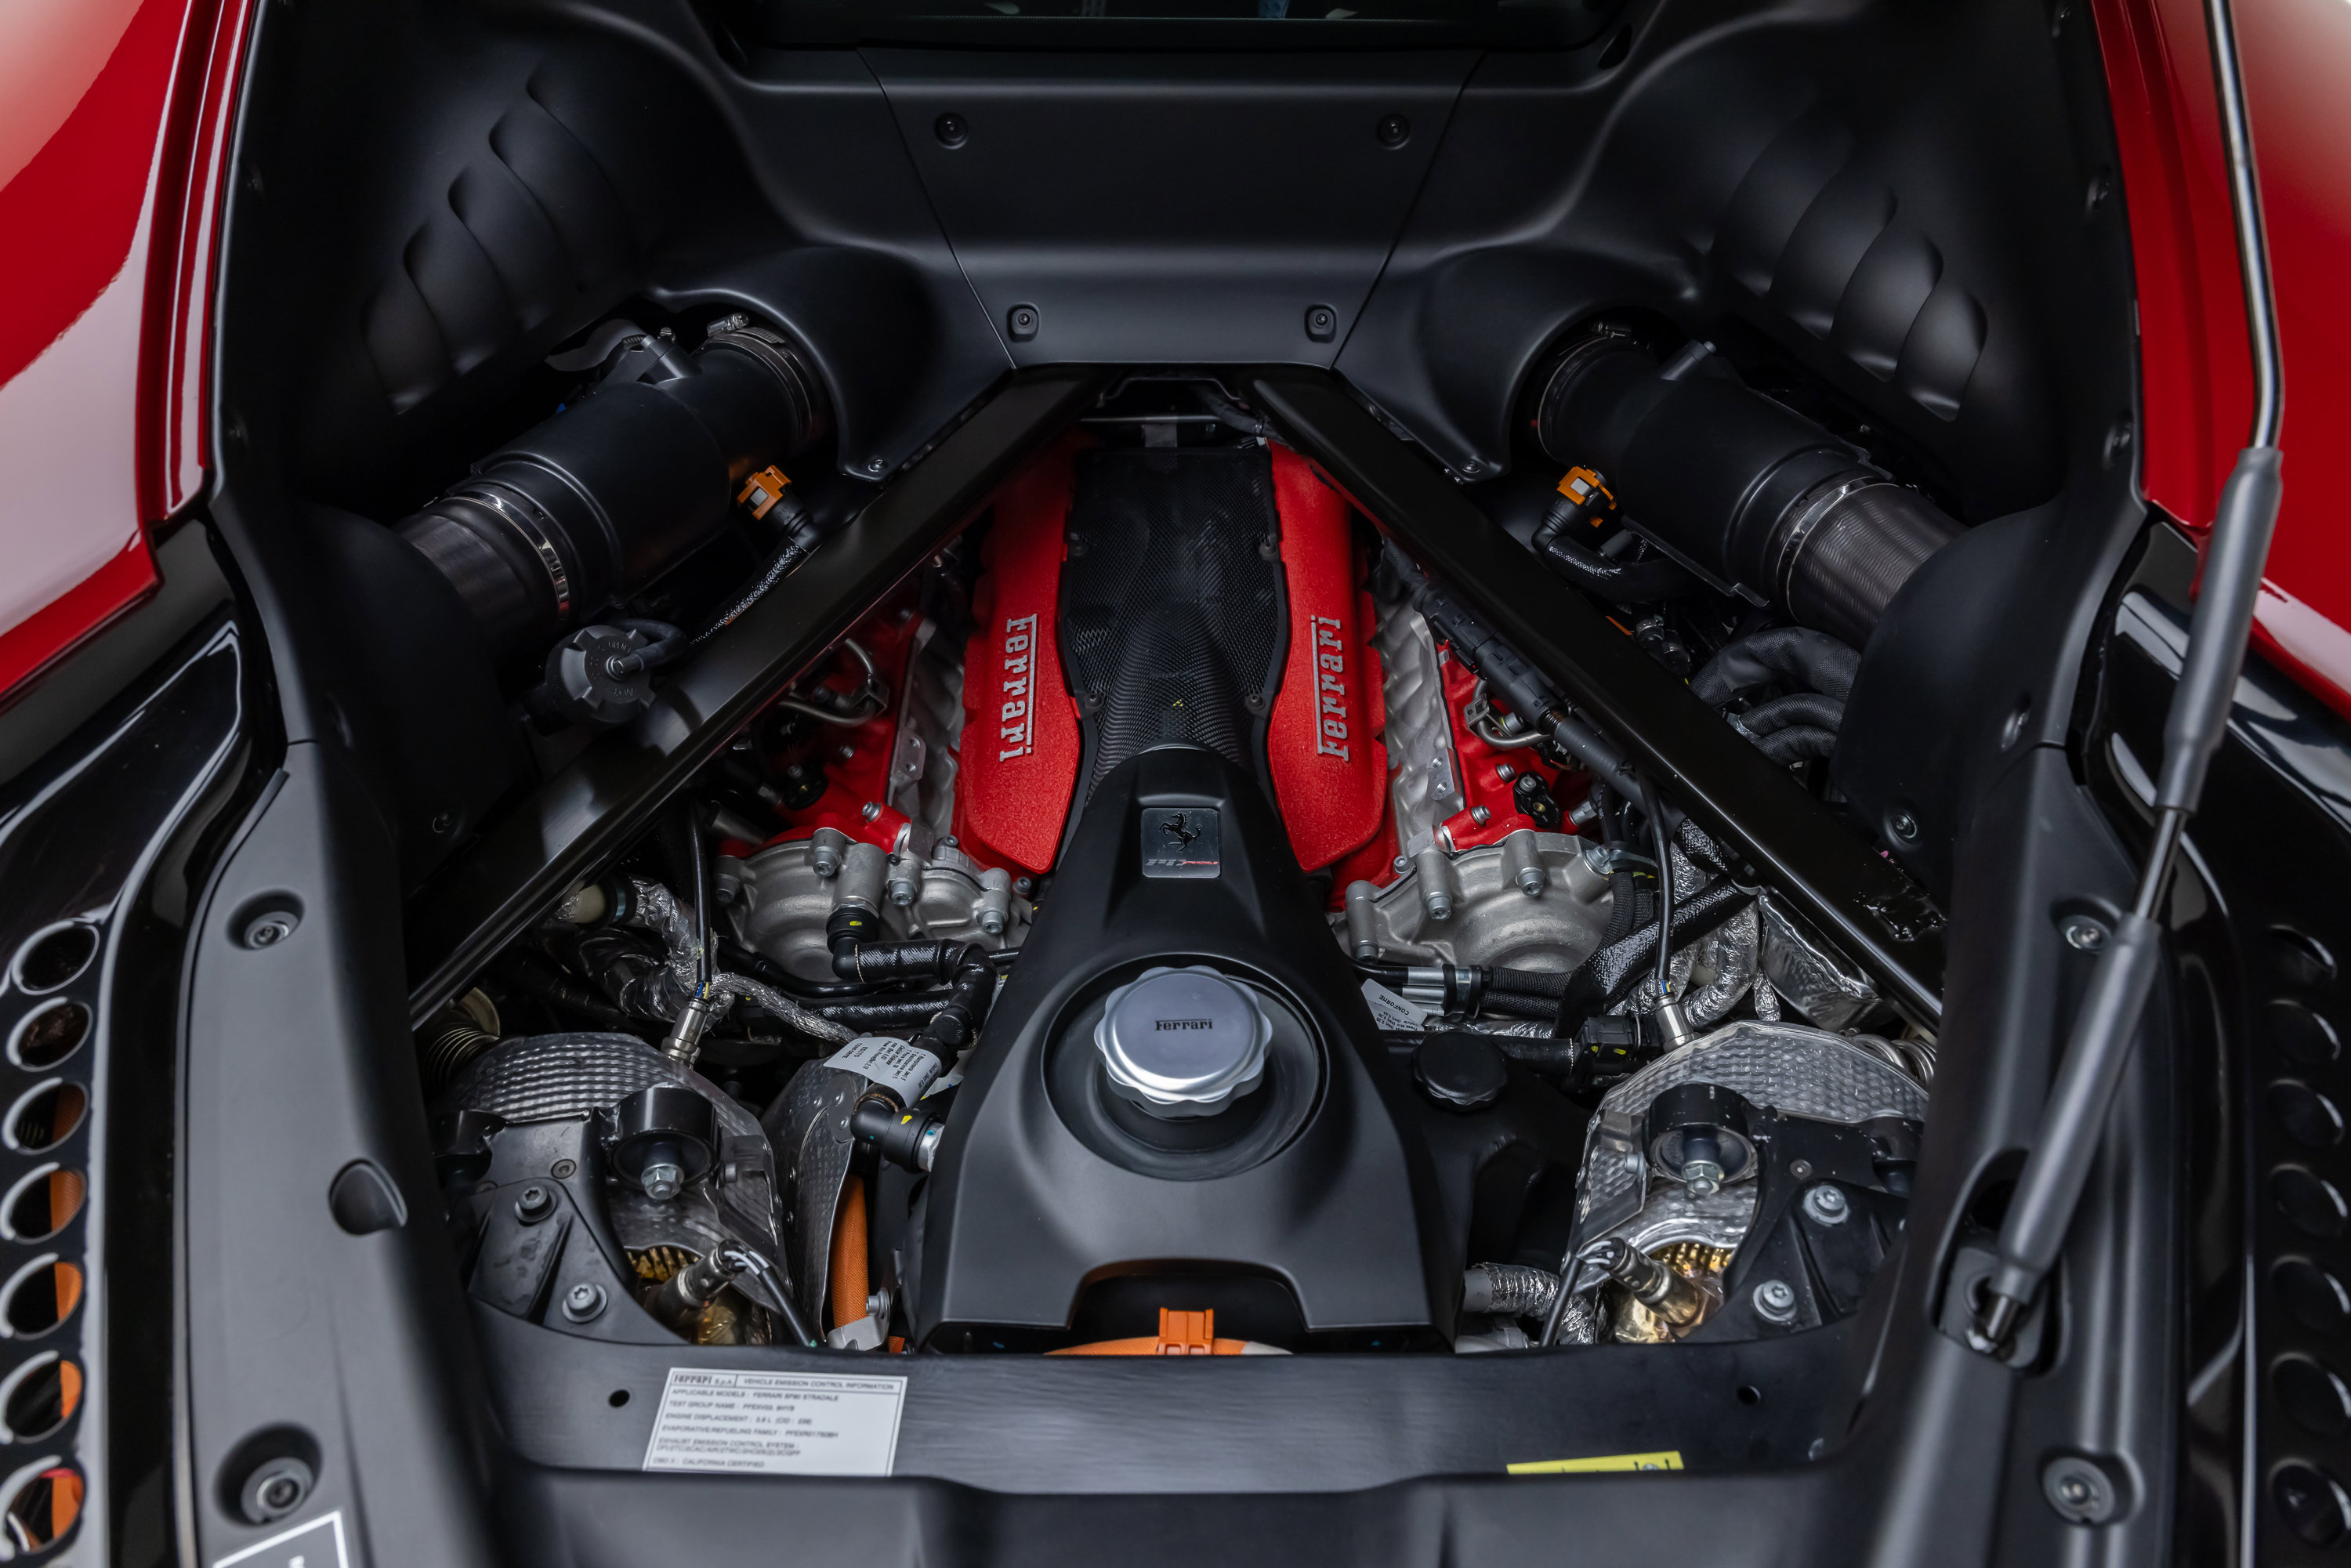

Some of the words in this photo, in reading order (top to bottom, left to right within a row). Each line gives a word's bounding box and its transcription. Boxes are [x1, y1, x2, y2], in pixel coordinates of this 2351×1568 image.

[999, 613, 1038, 762] Ferrari
[1310, 614, 1349, 762] Ferrari
[1154, 1019, 1213, 1030] Ferrari
[1378, 994, 1410, 1016] CONFORME
